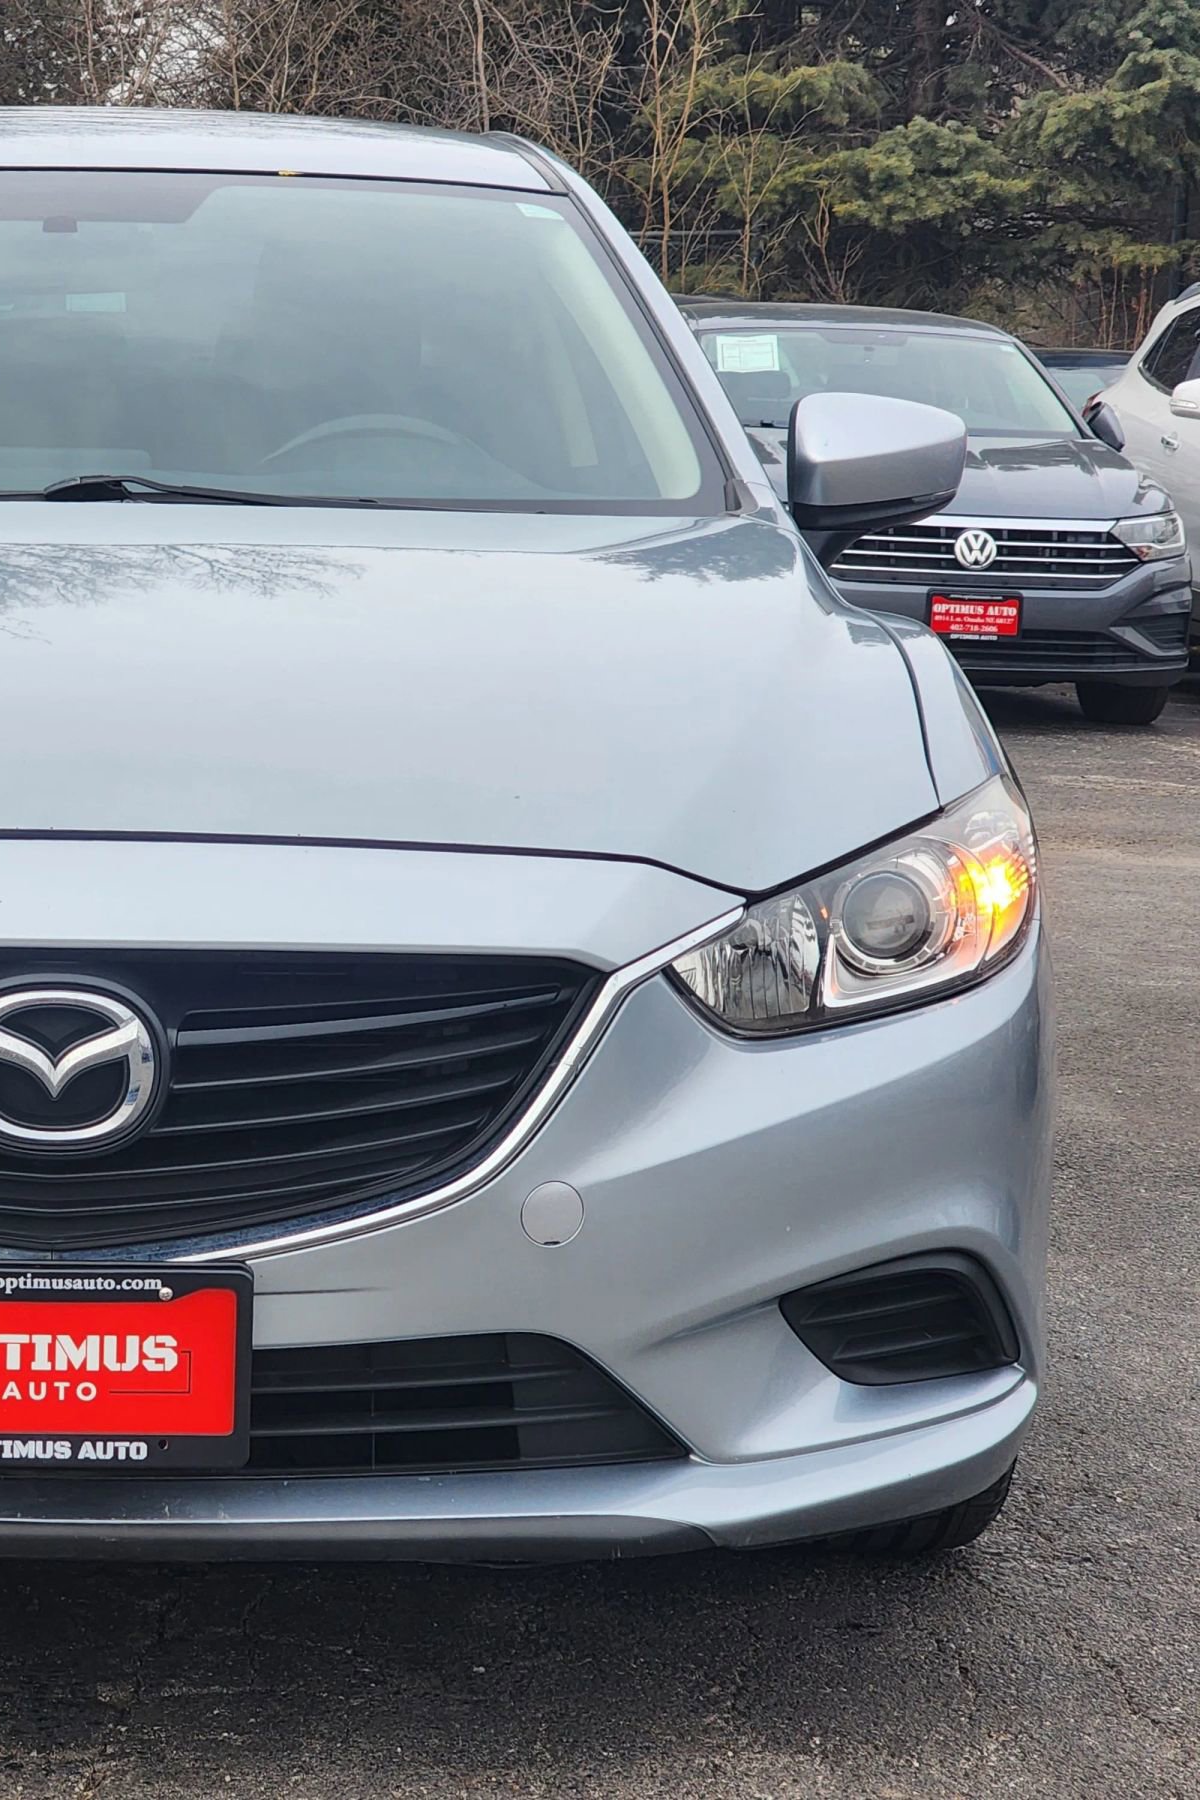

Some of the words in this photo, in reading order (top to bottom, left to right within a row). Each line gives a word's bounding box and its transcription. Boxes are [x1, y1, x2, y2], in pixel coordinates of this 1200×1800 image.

[933, 603, 984, 615] OPTIMUS
[986, 606, 1017, 616] AUTO
[2, 1381, 98, 1401] AUTO
[77, 1441, 148, 1460] AUTO
